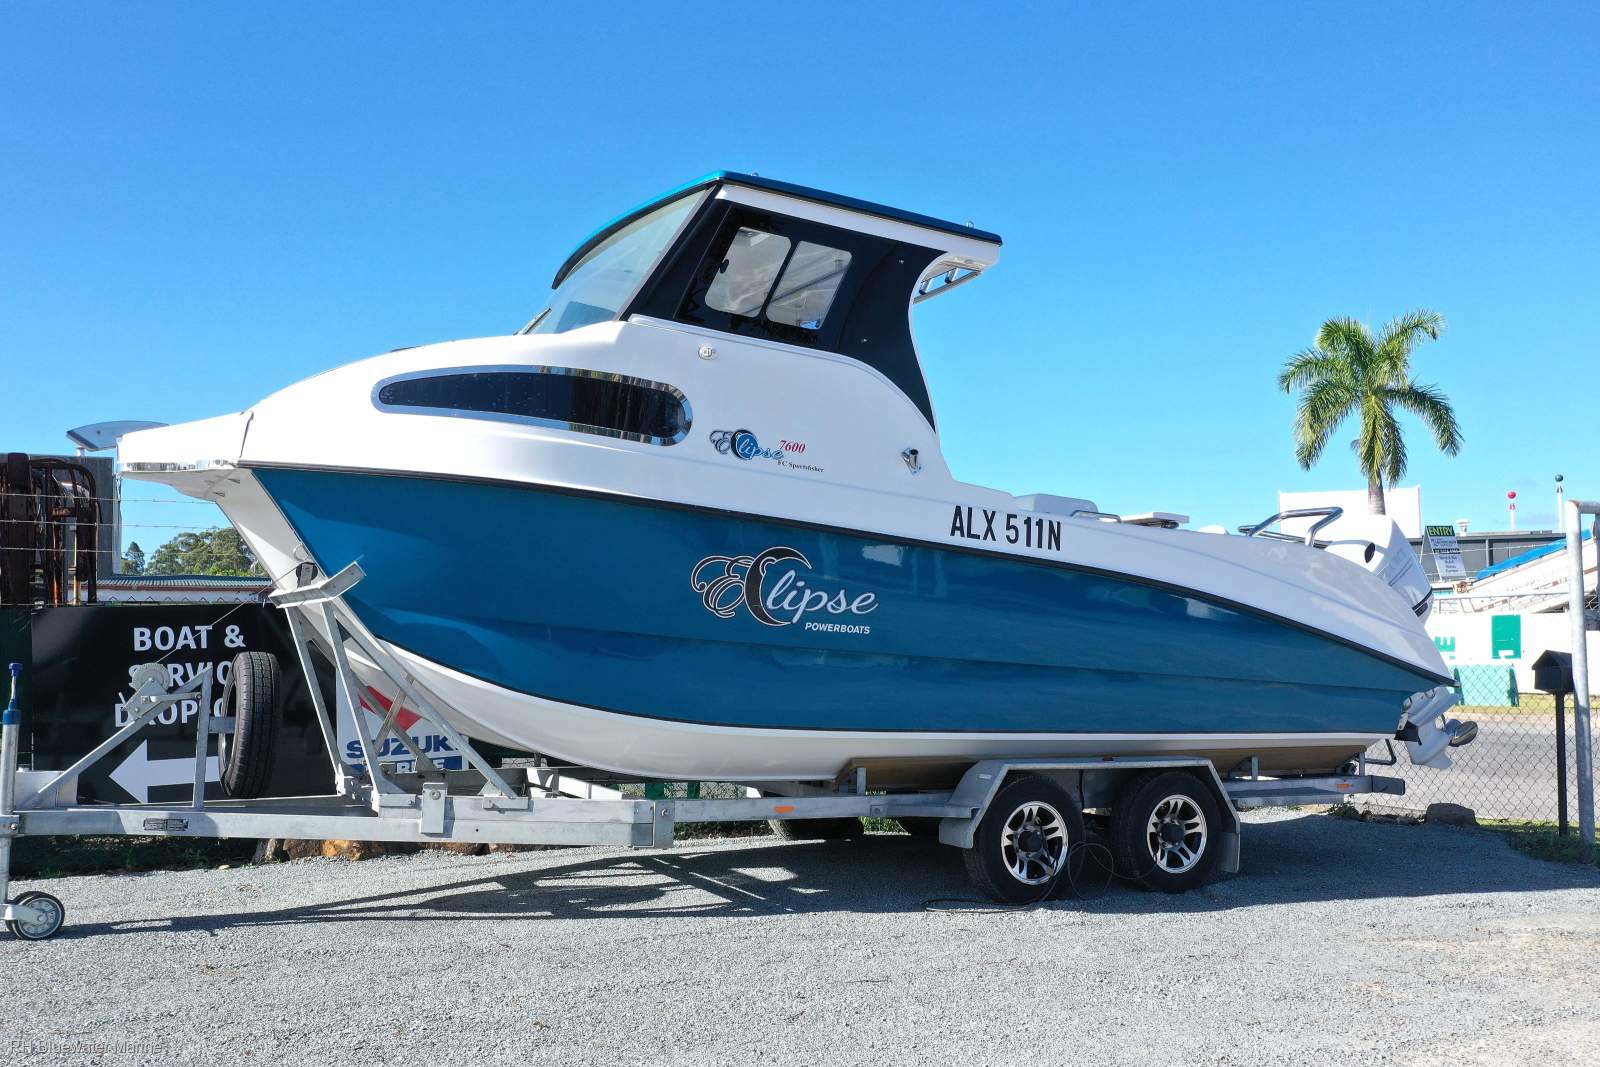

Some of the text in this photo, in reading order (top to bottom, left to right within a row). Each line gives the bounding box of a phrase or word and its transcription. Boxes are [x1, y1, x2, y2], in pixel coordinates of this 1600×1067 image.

[779, 440, 806, 454] 7600
[950, 505, 1061, 551] ALX 511N
[1428, 526, 1454, 536] ENTRY
[133, 624, 247, 651] BOAT &
[805, 622, 871, 635] POWERBOATS
[346, 734, 455, 759] SUZUK
